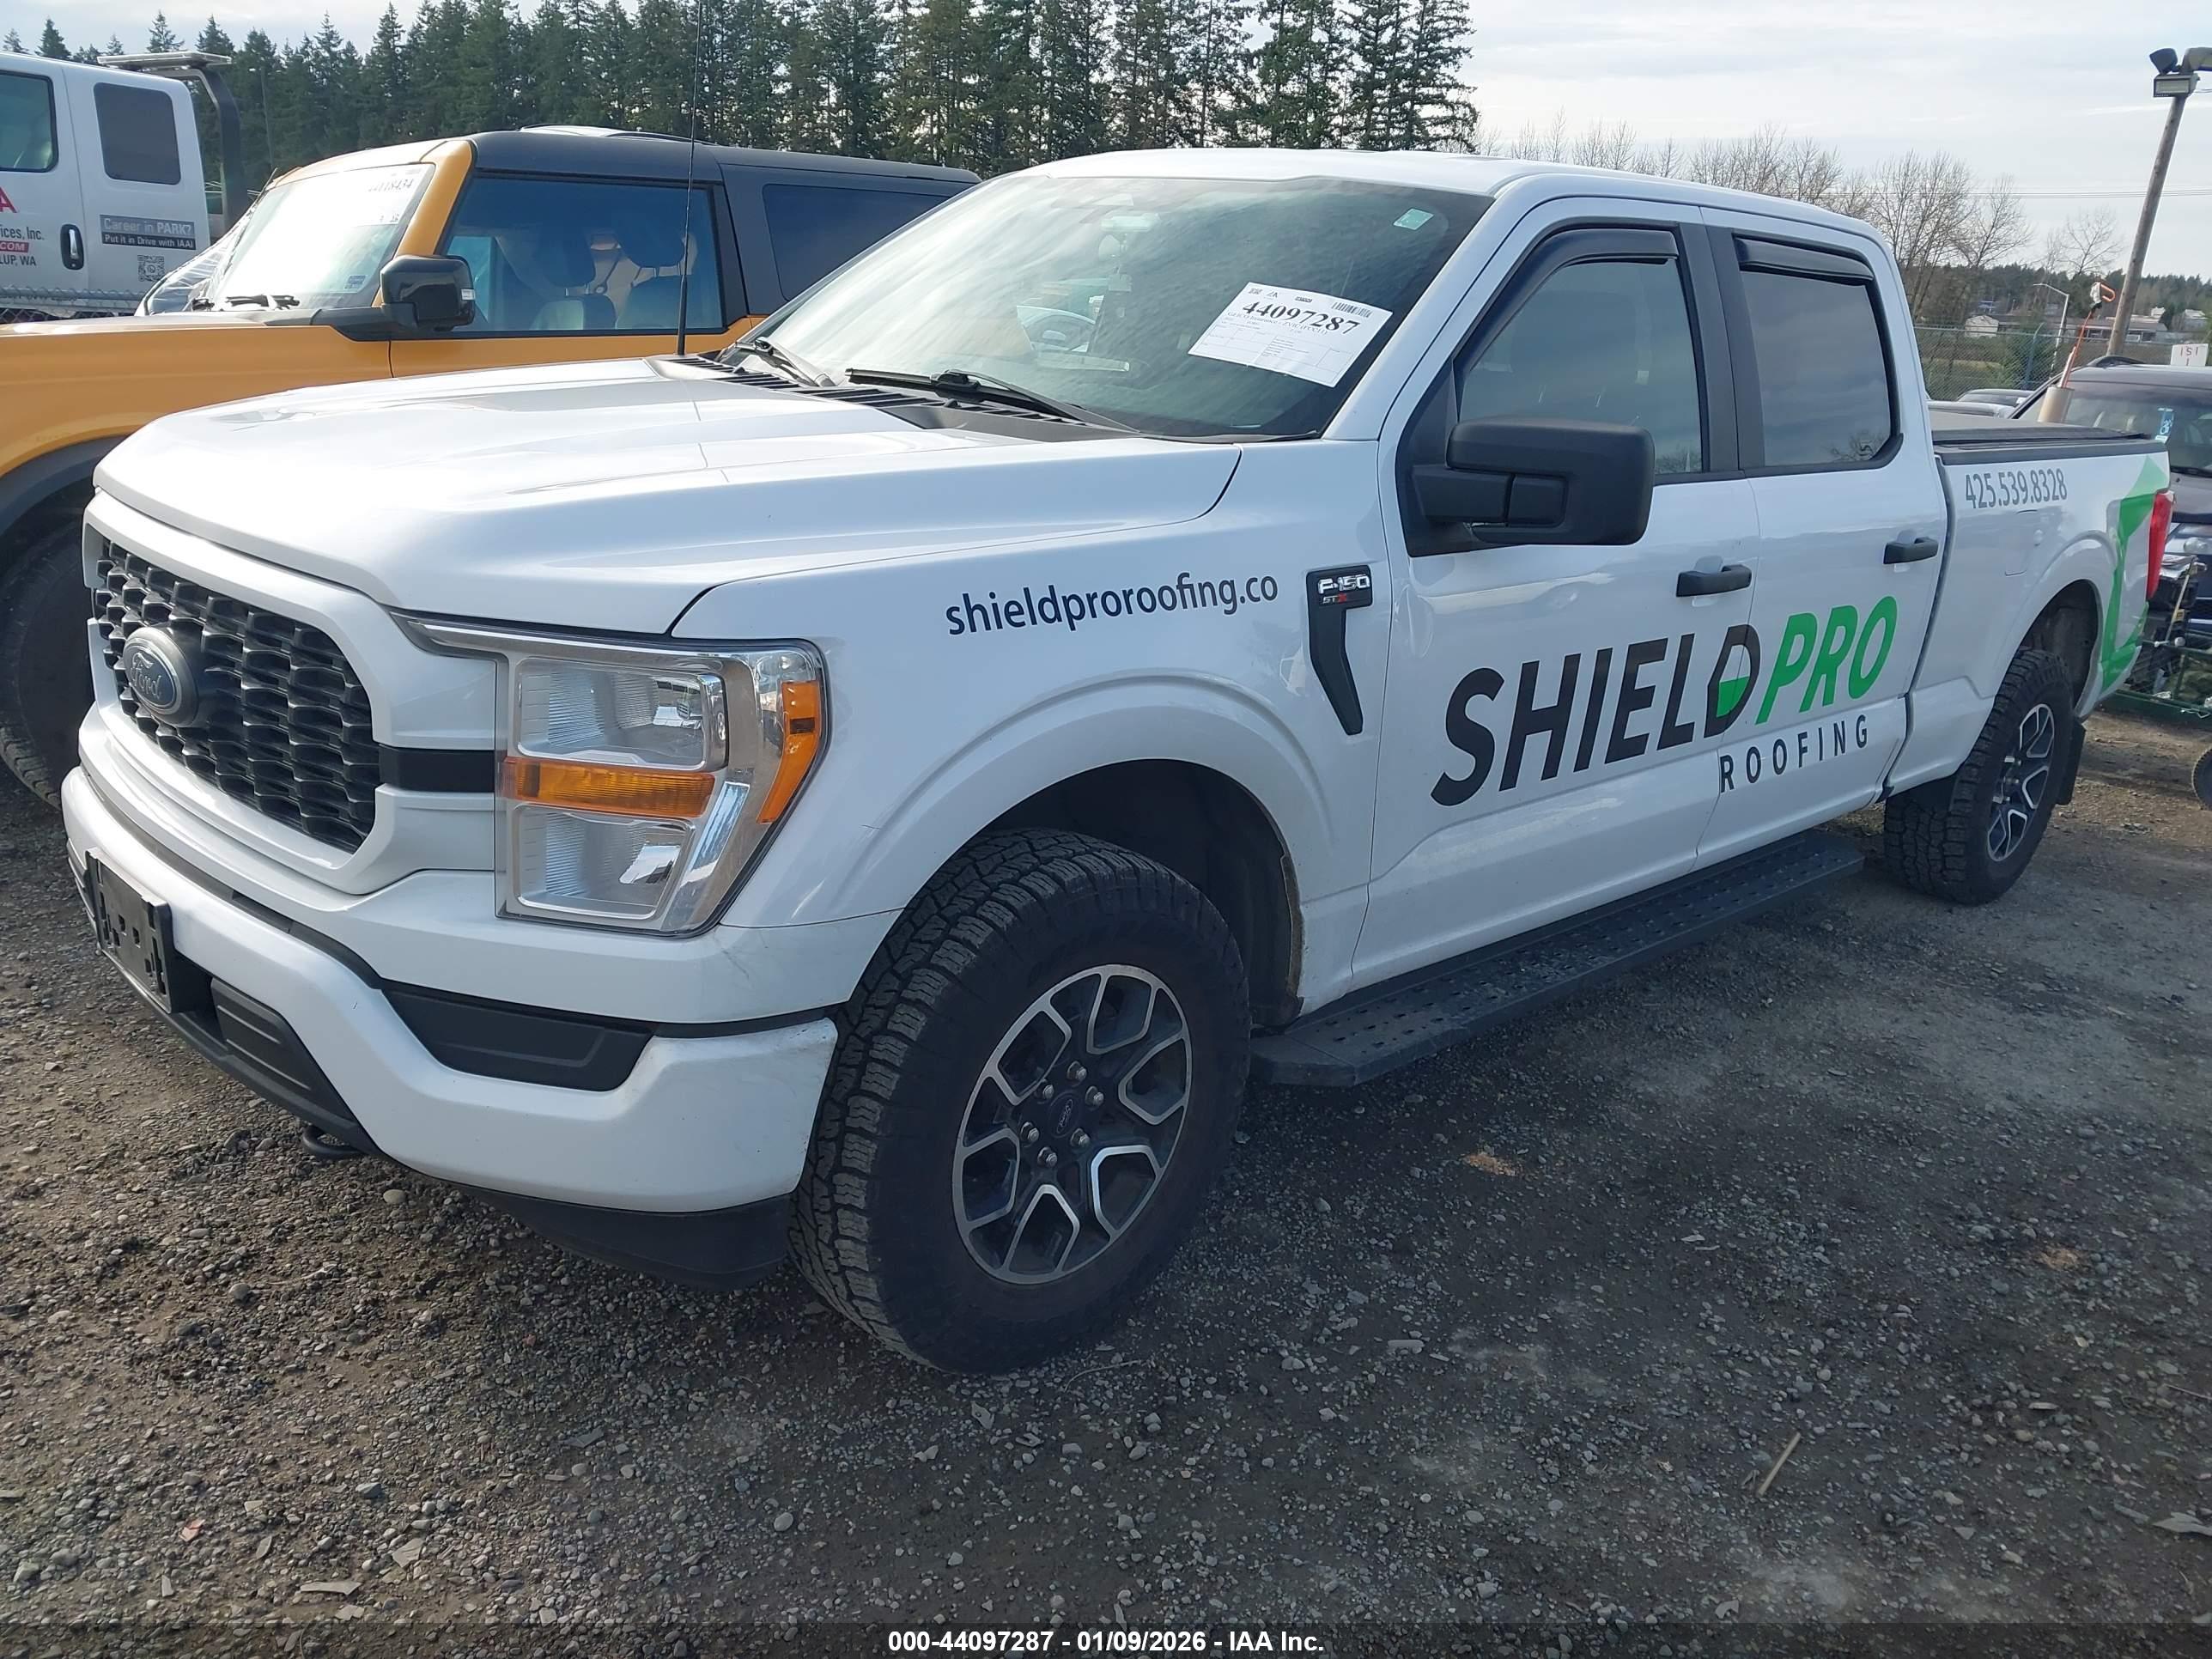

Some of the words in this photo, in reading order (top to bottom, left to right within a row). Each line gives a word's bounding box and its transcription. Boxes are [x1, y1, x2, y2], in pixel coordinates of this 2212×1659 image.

[27, 226, 45, 240] Inc.
[104, 218, 140, 231] Career
[143, 221, 154, 232] in
[157, 222, 191, 235] PARK?
[105, 234, 118, 243] Put
[120, 234, 125, 243] it
[128, 235, 135, 244] in
[137, 237, 156, 246] Drive
[20, 255, 36, 266] WA
[1243, 301, 1360, 335] 44097287
[1966, 468, 2068, 509] 425.539.8328
[1318, 574, 1370, 594] F-150
[945, 572, 1278, 635] shieldproroofing.co
[1720, 714, 1868, 793] ROOFING
